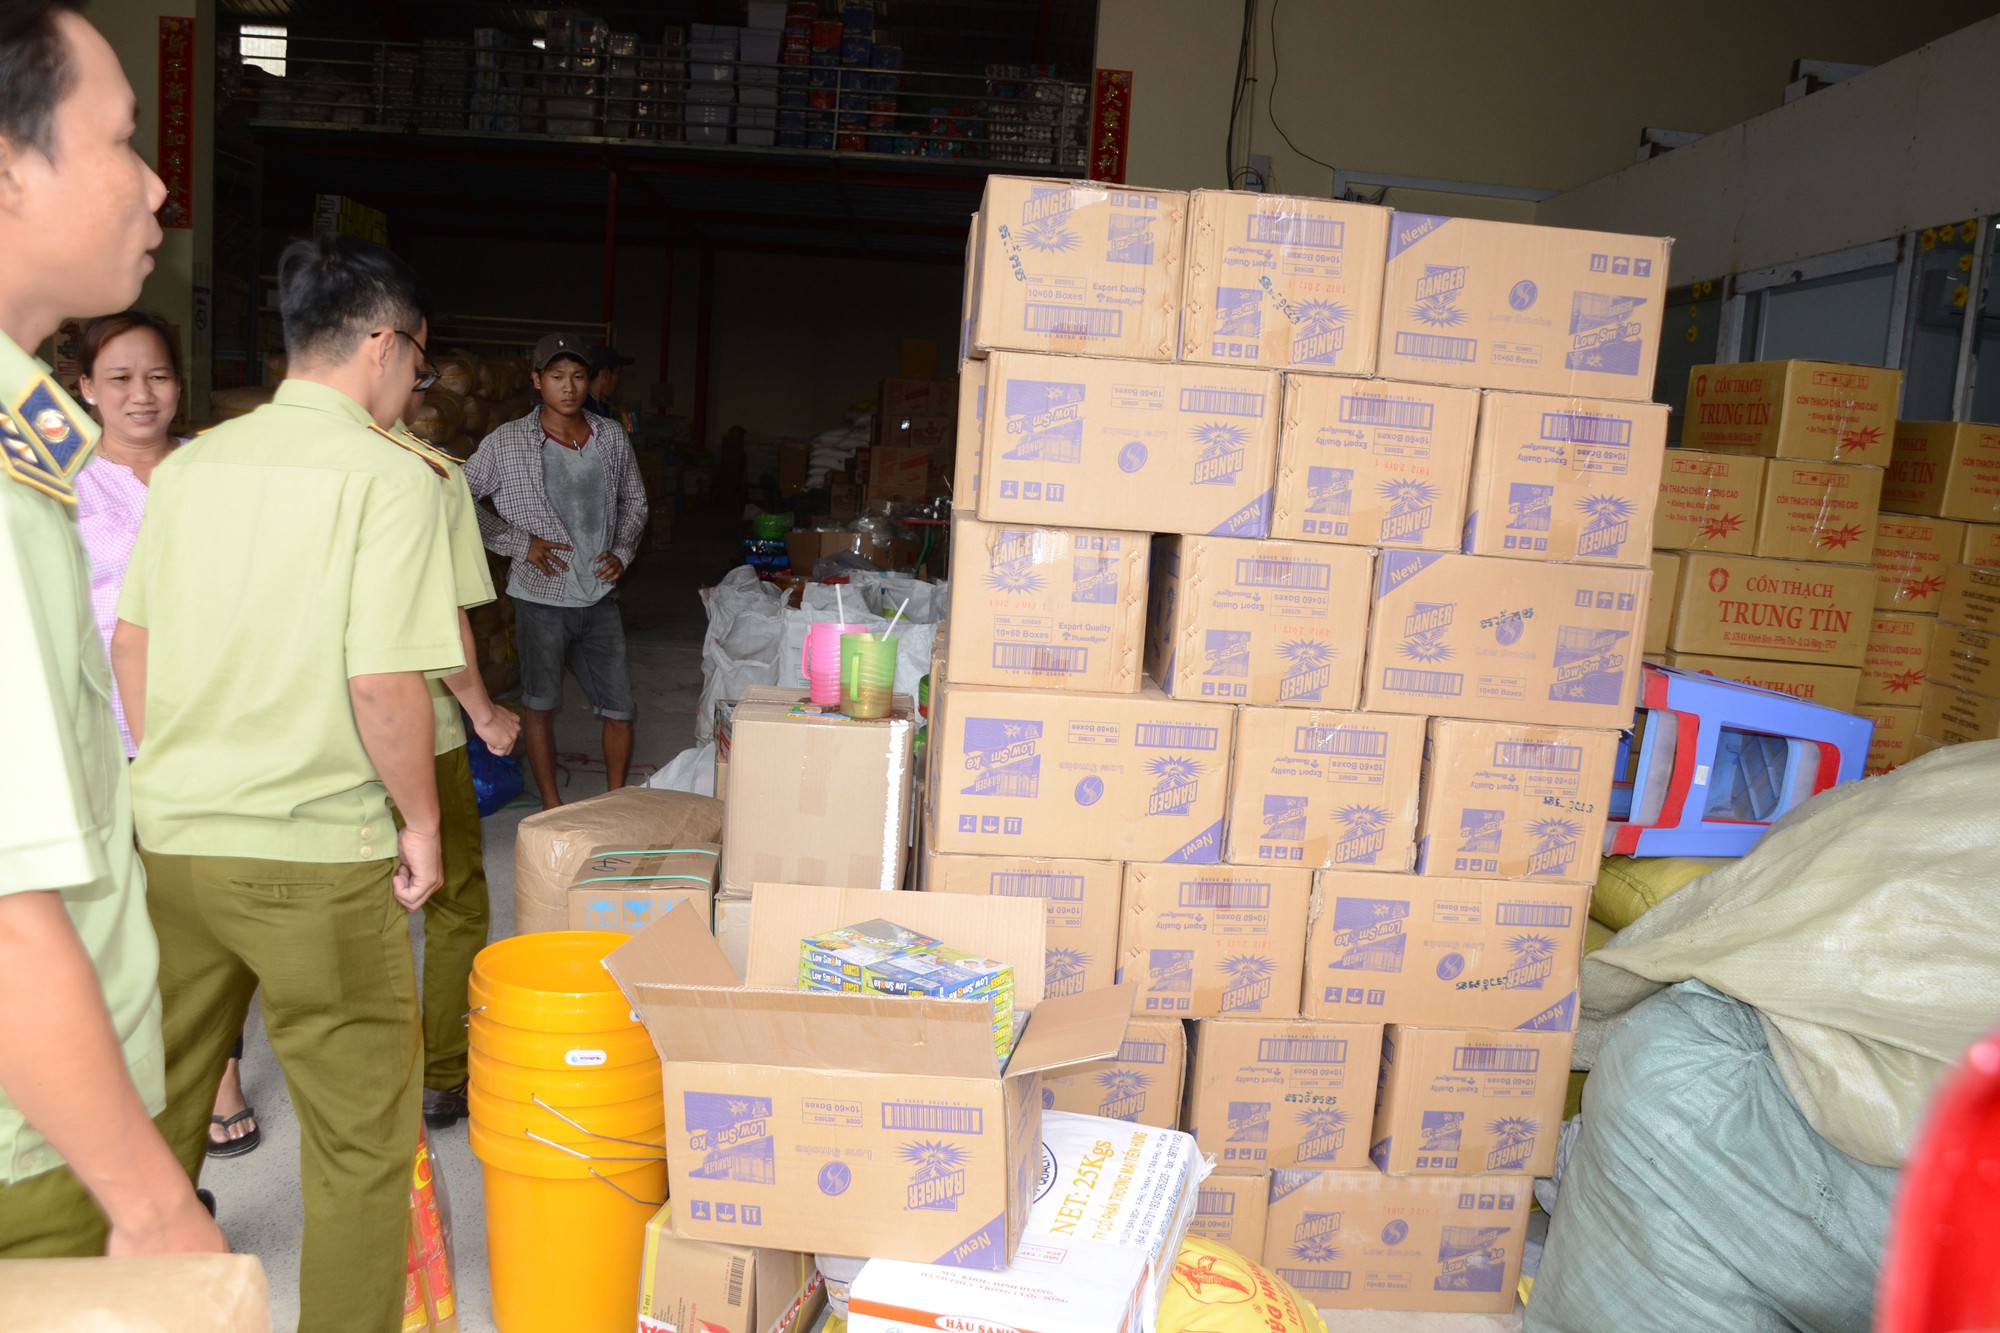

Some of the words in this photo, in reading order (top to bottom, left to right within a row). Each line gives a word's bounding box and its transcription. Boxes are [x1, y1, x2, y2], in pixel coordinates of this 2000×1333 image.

[1401, 218, 1433, 245] New!
[1416, 266, 1465, 301] RANGER
[1293, 326, 1345, 364] RANGER
[1574, 332, 1599, 348] Low
[1007, 411, 1052, 434] Smke
[1052, 404, 1078, 421] Low
[1700, 403, 1743, 425] TRUNG
[1746, 399, 1771, 425] TÍN
[1194, 448, 1245, 485] RANGER
[1229, 504, 1261, 532] New!
[1381, 505, 1432, 541] RANGER
[1579, 520, 1628, 555] RANGER
[1391, 558, 1422, 585] New!
[1782, 580, 1834, 599] THẠCH
[1405, 604, 1453, 638] RANGER
[1719, 600, 1804, 629] TRUNG
[1809, 603, 1852, 633] TÍN
[1280, 664, 1330, 701] RANGER
[1558, 665, 1582, 681] Low
[1009, 741, 1035, 756] Low
[1149, 780, 1198, 816] RANGER
[1183, 833, 1213, 860] New!
[1336, 828, 1385, 863] RANGER
[1527, 841, 1576, 875] RANGER
[1378, 920, 1402, 934] Low
[812, 953, 822, 962] Low
[812, 971, 821, 980] Low
[975, 976, 988, 988] Low
[1506, 956, 1552, 989] RANGER
[895, 983, 907, 992] Low
[1222, 977, 1271, 1012] RANGER
[1533, 1005, 1563, 1028] New!
[740, 1119, 765, 1137] Low
[1298, 1128, 1344, 1162] RANGER
[1487, 1138, 1534, 1170] RANGER
[907, 1168, 965, 1210] RANGER
[1050, 1192, 1090, 1236] NET:
[1073, 1140, 1114, 1190] 25Kgs
[1295, 1212, 1341, 1243] RANGER
[953, 1232, 992, 1264] New!
[1442, 1259, 1465, 1274] Low
